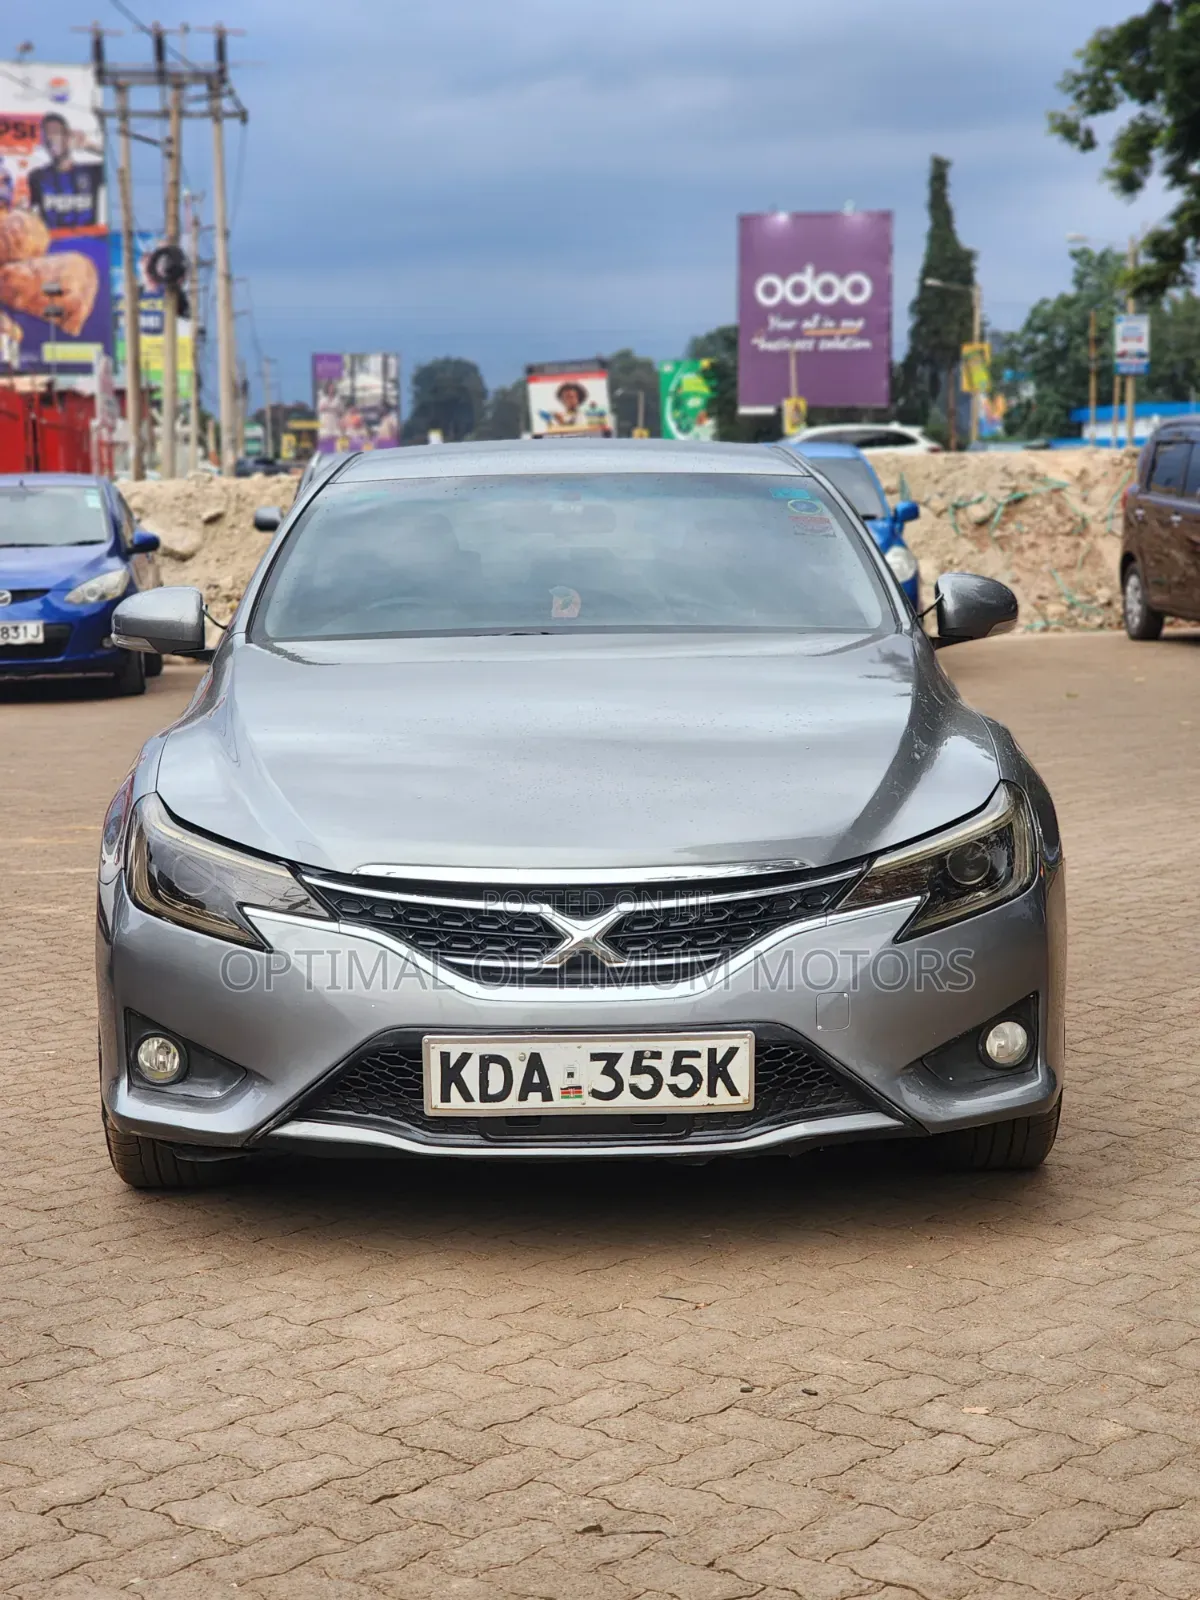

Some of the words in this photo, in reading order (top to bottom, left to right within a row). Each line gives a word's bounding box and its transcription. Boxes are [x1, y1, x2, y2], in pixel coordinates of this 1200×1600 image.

[755, 261, 872, 307] odoo
[0, 625, 40, 640] 831J
[438, 1050, 555, 1104] KDA
[587, 1046, 741, 1101] 355K
